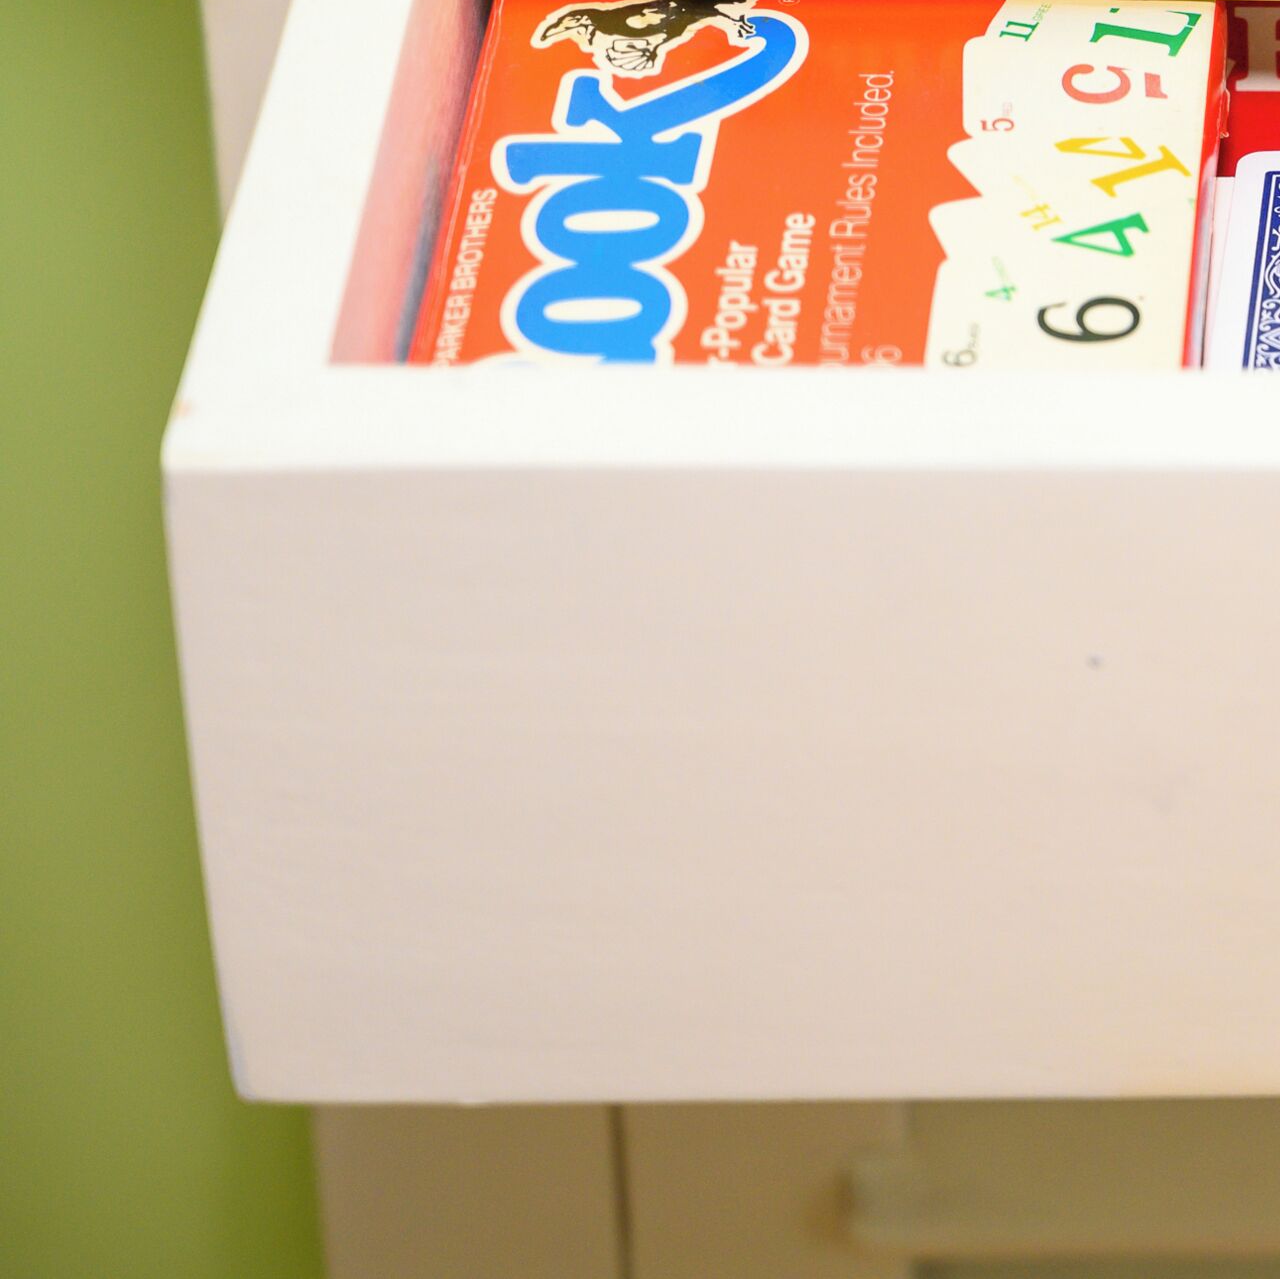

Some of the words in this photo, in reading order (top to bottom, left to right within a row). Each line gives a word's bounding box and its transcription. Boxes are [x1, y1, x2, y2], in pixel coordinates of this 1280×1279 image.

[841, 69, 896, 168] Included.
[504, 14, 798, 364] ook
[828, 173, 878, 240] Rules
[451, 186, 498, 295] BROTHERS
[763, 212, 816, 293] Game
[750, 297, 801, 367] Card
[1036, 296, 1141, 343] 6
